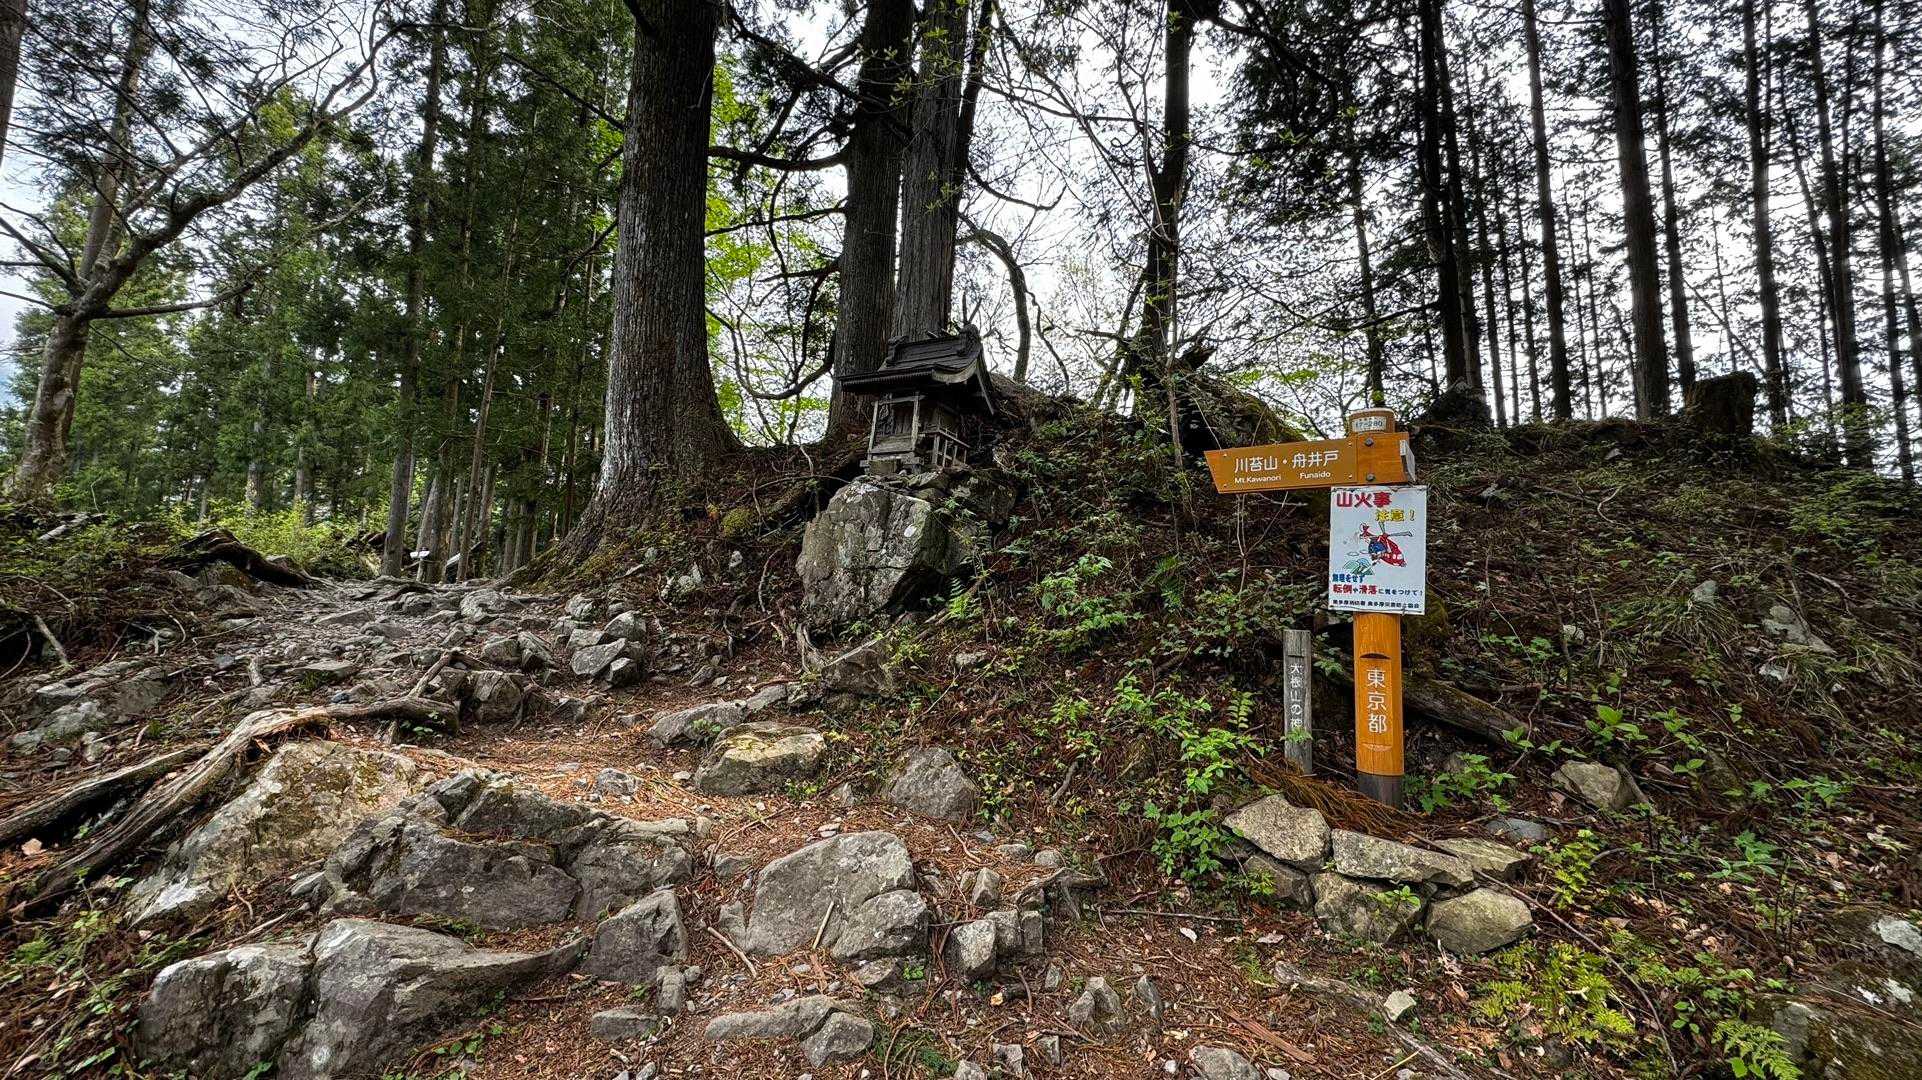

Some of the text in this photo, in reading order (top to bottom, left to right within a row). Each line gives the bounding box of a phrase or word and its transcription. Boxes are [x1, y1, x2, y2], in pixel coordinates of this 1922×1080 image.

[1299, 471, 1331, 480] Funaido
[1336, 491, 1392, 508] 山火事
[1366, 668, 1387, 734] 東京都
